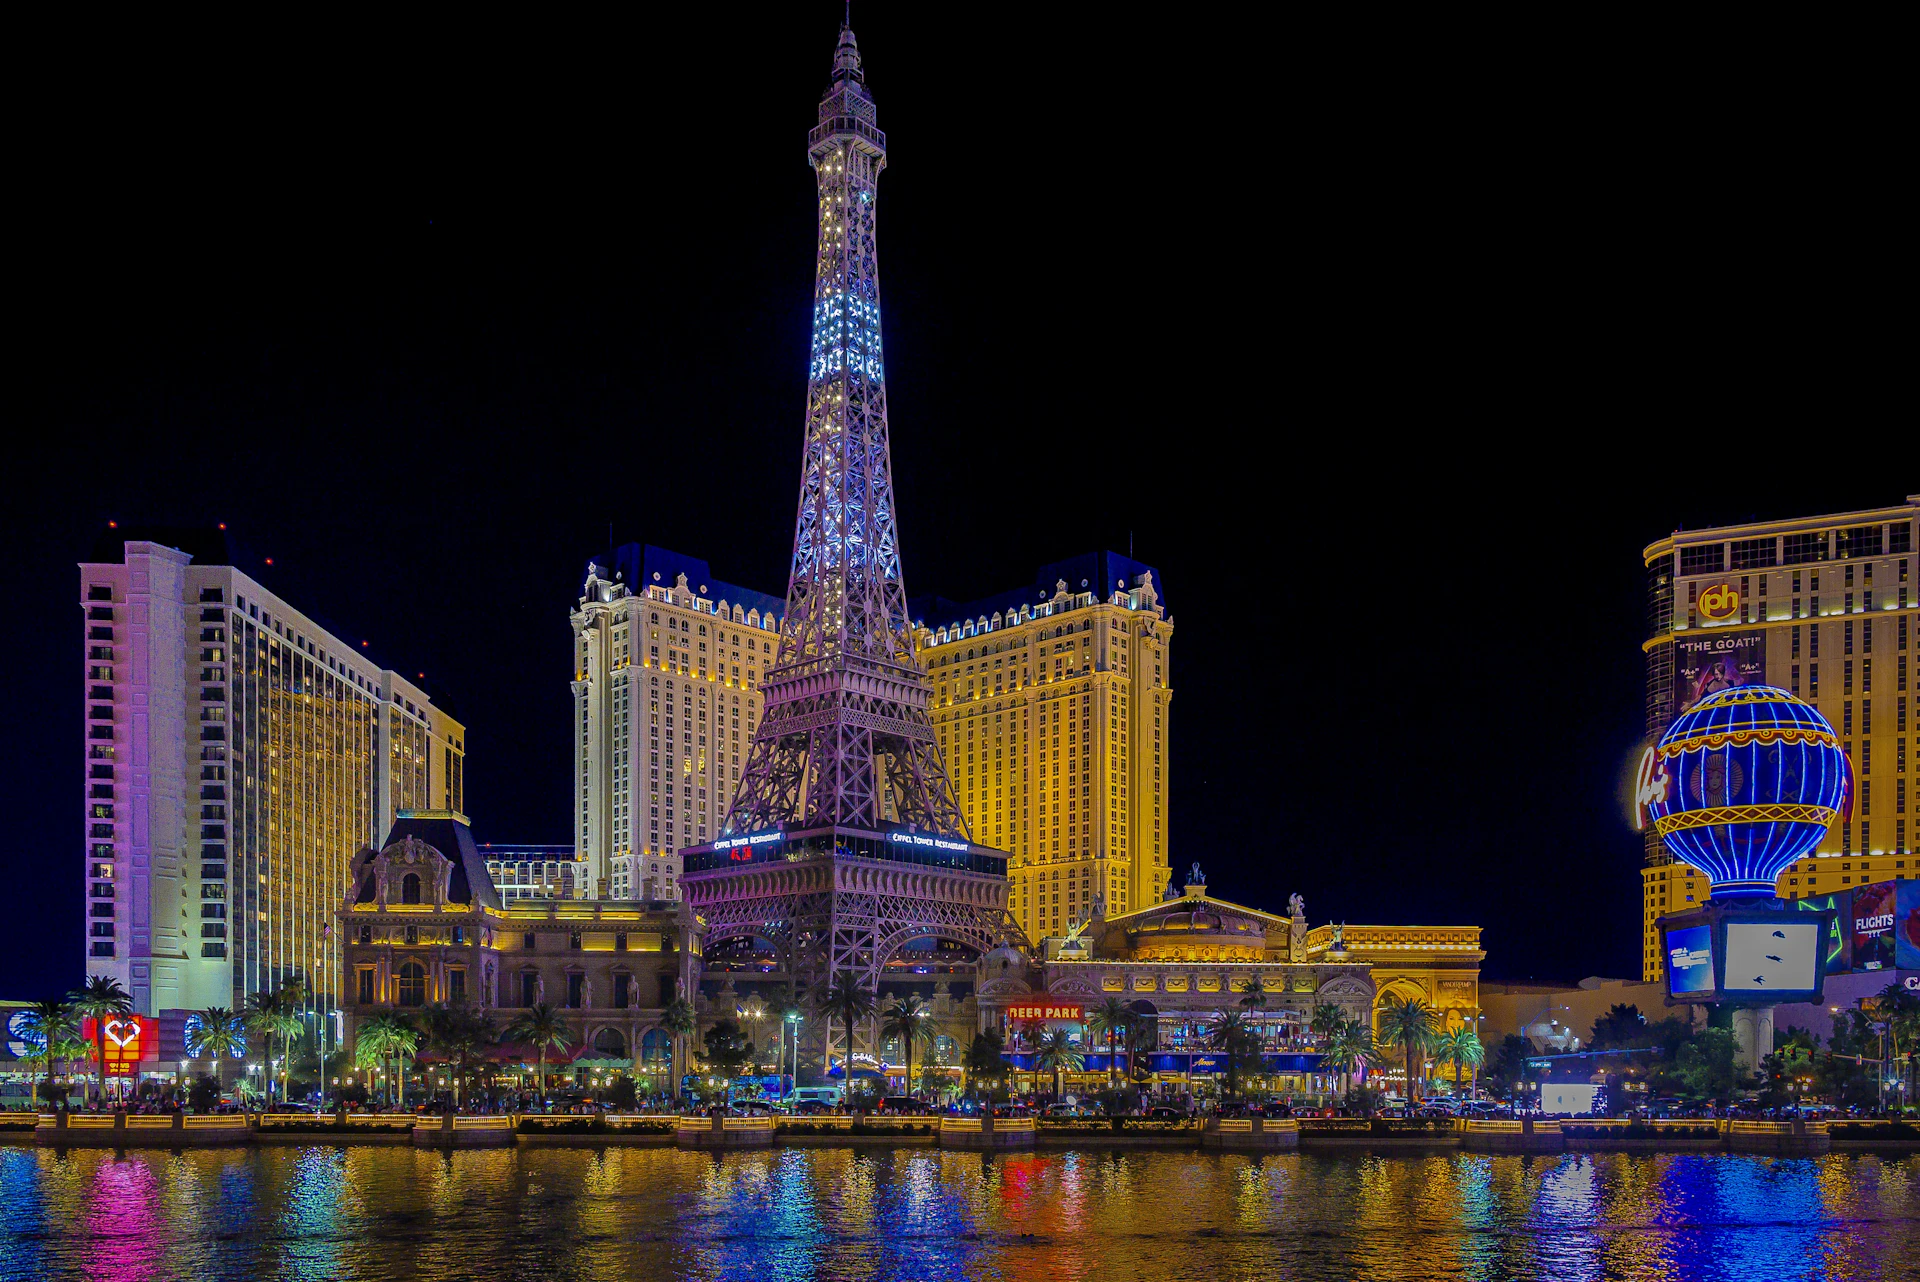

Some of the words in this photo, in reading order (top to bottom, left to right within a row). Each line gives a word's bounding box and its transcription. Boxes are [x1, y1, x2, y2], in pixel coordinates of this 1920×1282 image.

[1704, 584, 1739, 615] ph
[731, 838, 749, 847] TOWER
[892, 833, 912, 844] EIFFEL
[913, 836, 934, 846] TOWER
[935, 839, 968, 851] RESTAURANT
[1856, 914, 1894, 930] FLIGHTS
[1009, 1007, 1042, 1018] BEER
[1045, 1007, 1079, 1019] PARK
